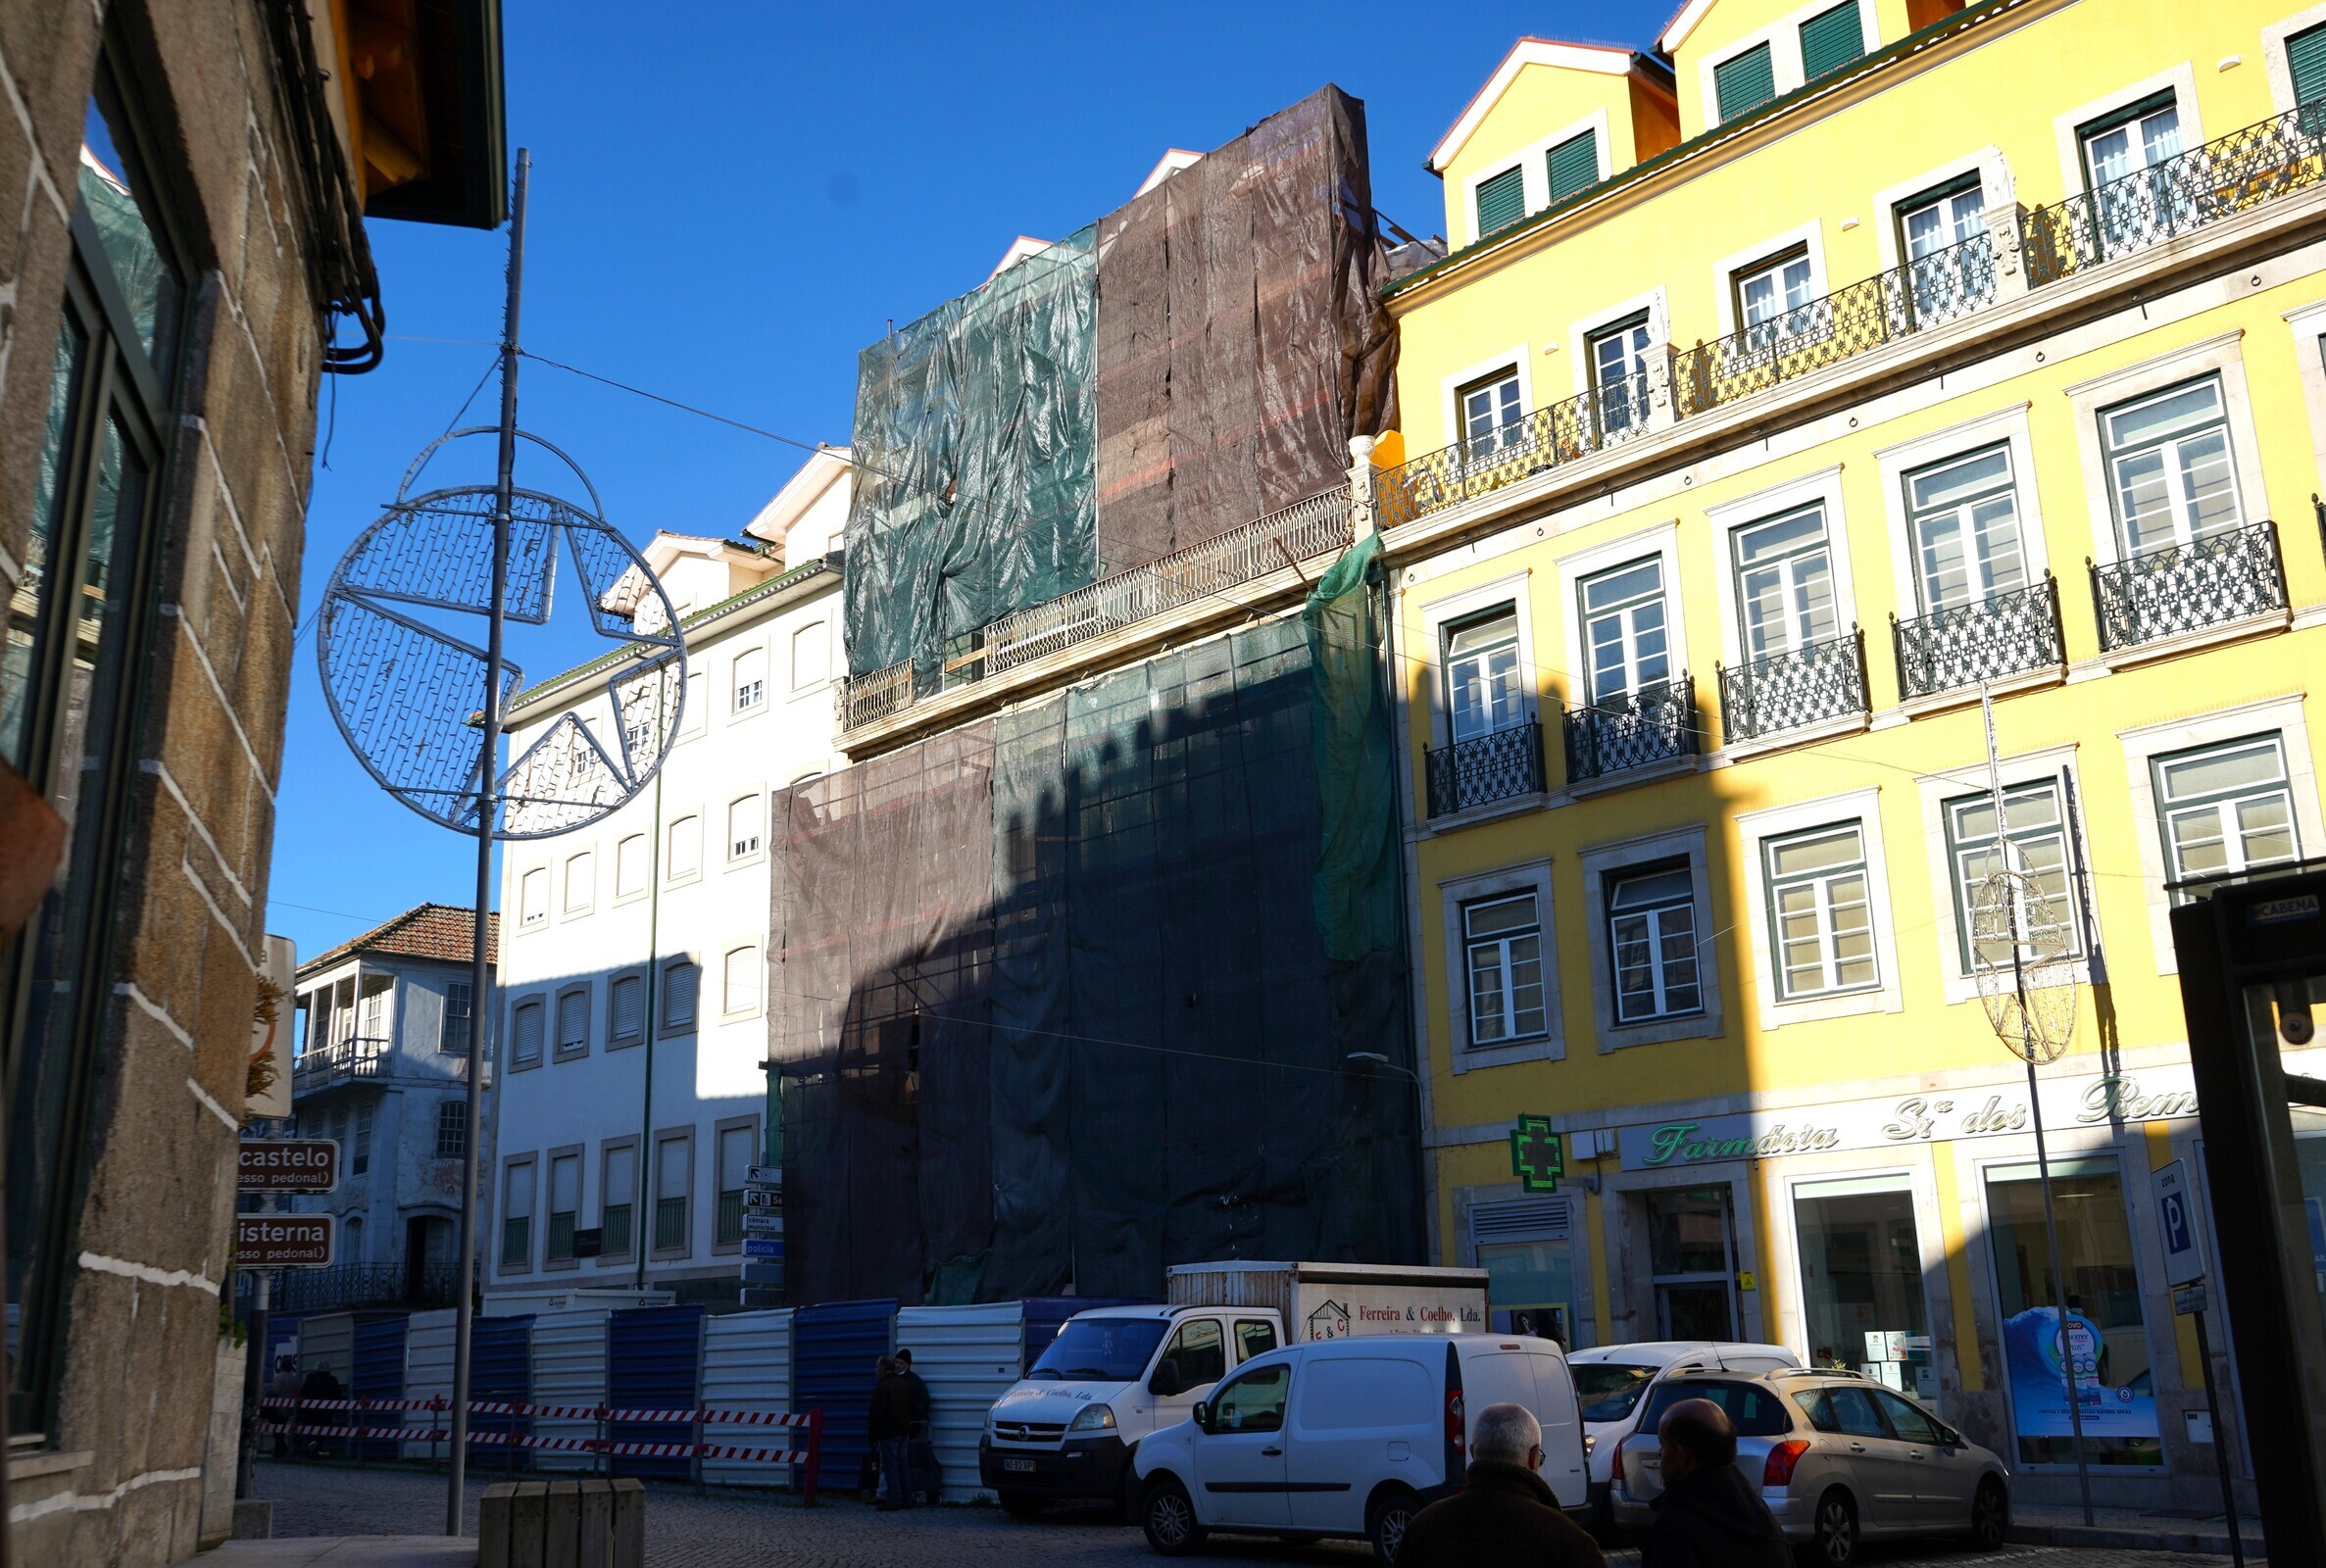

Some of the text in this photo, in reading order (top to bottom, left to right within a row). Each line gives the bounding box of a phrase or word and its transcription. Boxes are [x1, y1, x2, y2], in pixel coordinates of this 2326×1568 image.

[2261, 899, 2317, 916] CABENA
[1643, 1123, 1840, 1164] Farmácia
[1962, 1095, 2026, 1134] dos
[239, 1147, 329, 1167] castelo
[271, 1171, 329, 1185] pedonal)
[2161, 1174, 2175, 1188] zona
[239, 1222, 324, 1242] isterna
[2166, 1197, 2182, 1249] P
[267, 1246, 324, 1260] pedonal)
[1360, 1305, 1481, 1324] Ferreira & Coelho, Lda.
[1337, 1318, 1345, 1332] C
